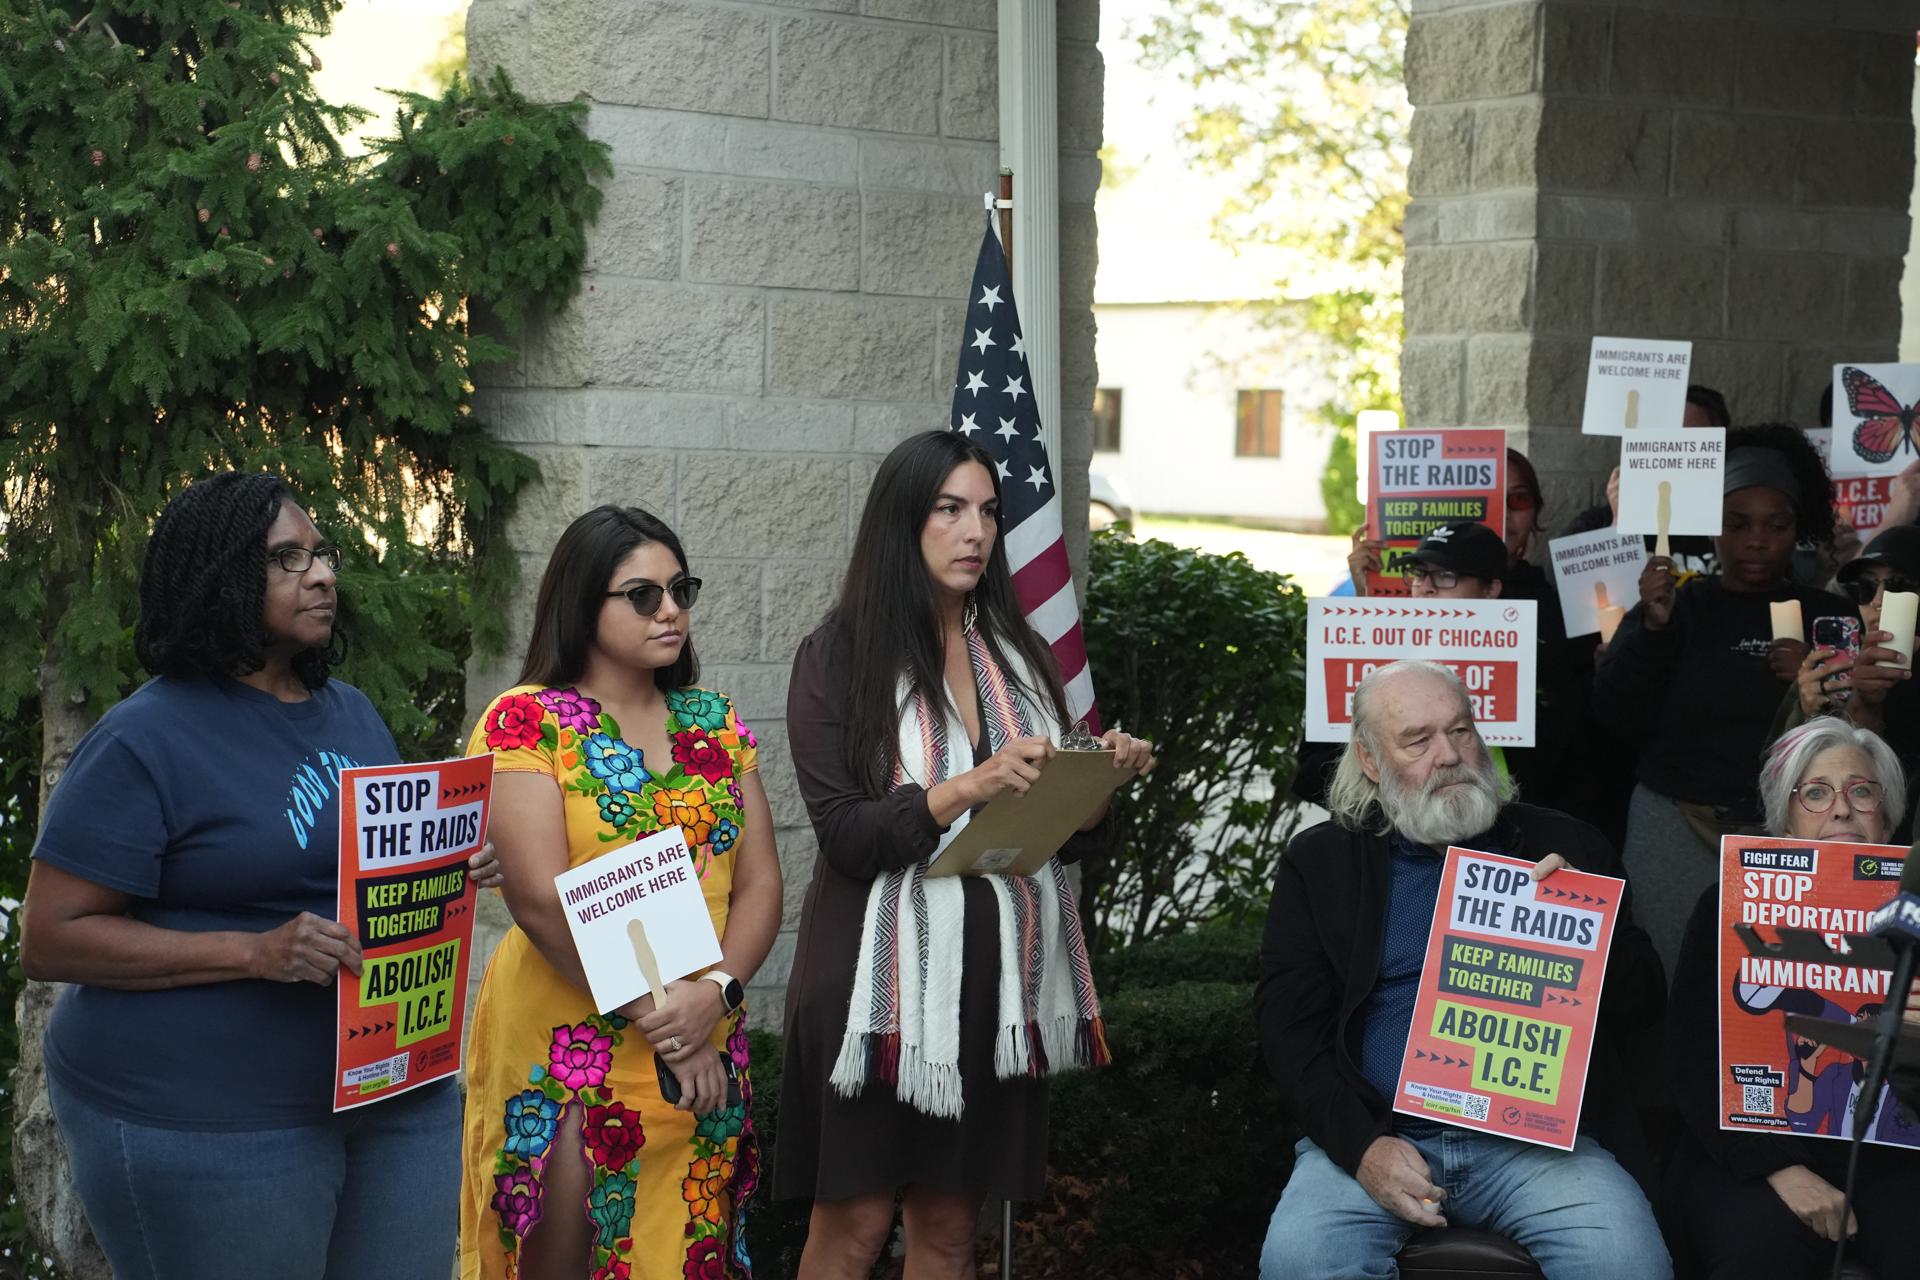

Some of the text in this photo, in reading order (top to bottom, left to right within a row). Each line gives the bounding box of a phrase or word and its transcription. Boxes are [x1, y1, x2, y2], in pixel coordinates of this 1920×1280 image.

[1595, 350, 1688, 365] IMMIGRANTS ARE
[1598, 365, 1682, 380] WELCOME HERE
[1384, 439, 1435, 459] STOP
[1625, 441, 1722, 452] IMMIGRANTS ARE
[1383, 464, 1492, 486] THE RAIDS
[1629, 458, 1717, 469] WELCOME HERE
[1384, 502, 1482, 517] KEEP FAMILIES
[1555, 534, 1642, 562] IMMIGRANTS ARE
[1561, 550, 1641, 576] WELCOME HERE
[1324, 626, 1518, 649] I.C.E. OUT OF CHICAGO
[1465, 665, 1496, 691] OF
[365, 779, 431, 815] STOP
[362, 811, 478, 859] THE RAIDS
[1743, 851, 1809, 868] FIGHT FEAR
[565, 843, 687, 906] IMMIGRANTS ARE
[1464, 863, 1530, 896] STOP
[1743, 871, 1813, 902] STOP
[367, 870, 464, 909] KEEP FAMILIES
[577, 867, 688, 924] WELCOME HERE
[367, 906, 439, 939] TOGETHER
[1457, 895, 1594, 945] THE RAIDS
[366, 944, 455, 1000] ABOLISH
[1451, 943, 1574, 984] KEEP FAMILIES
[1448, 967, 1534, 1001] TOGETHER
[403, 990, 447, 1036] I.C.E.
[1438, 1006, 1562, 1057] ABOLISH
[1481, 1053, 1551, 1095] I.C.E.
[1735, 1067, 1764, 1075] Defend
[1735, 1075, 1780, 1085] Your Rights
[1410, 1083, 1462, 1100] Know Your Rights
[1427, 1093, 1449, 1102] Hotline
